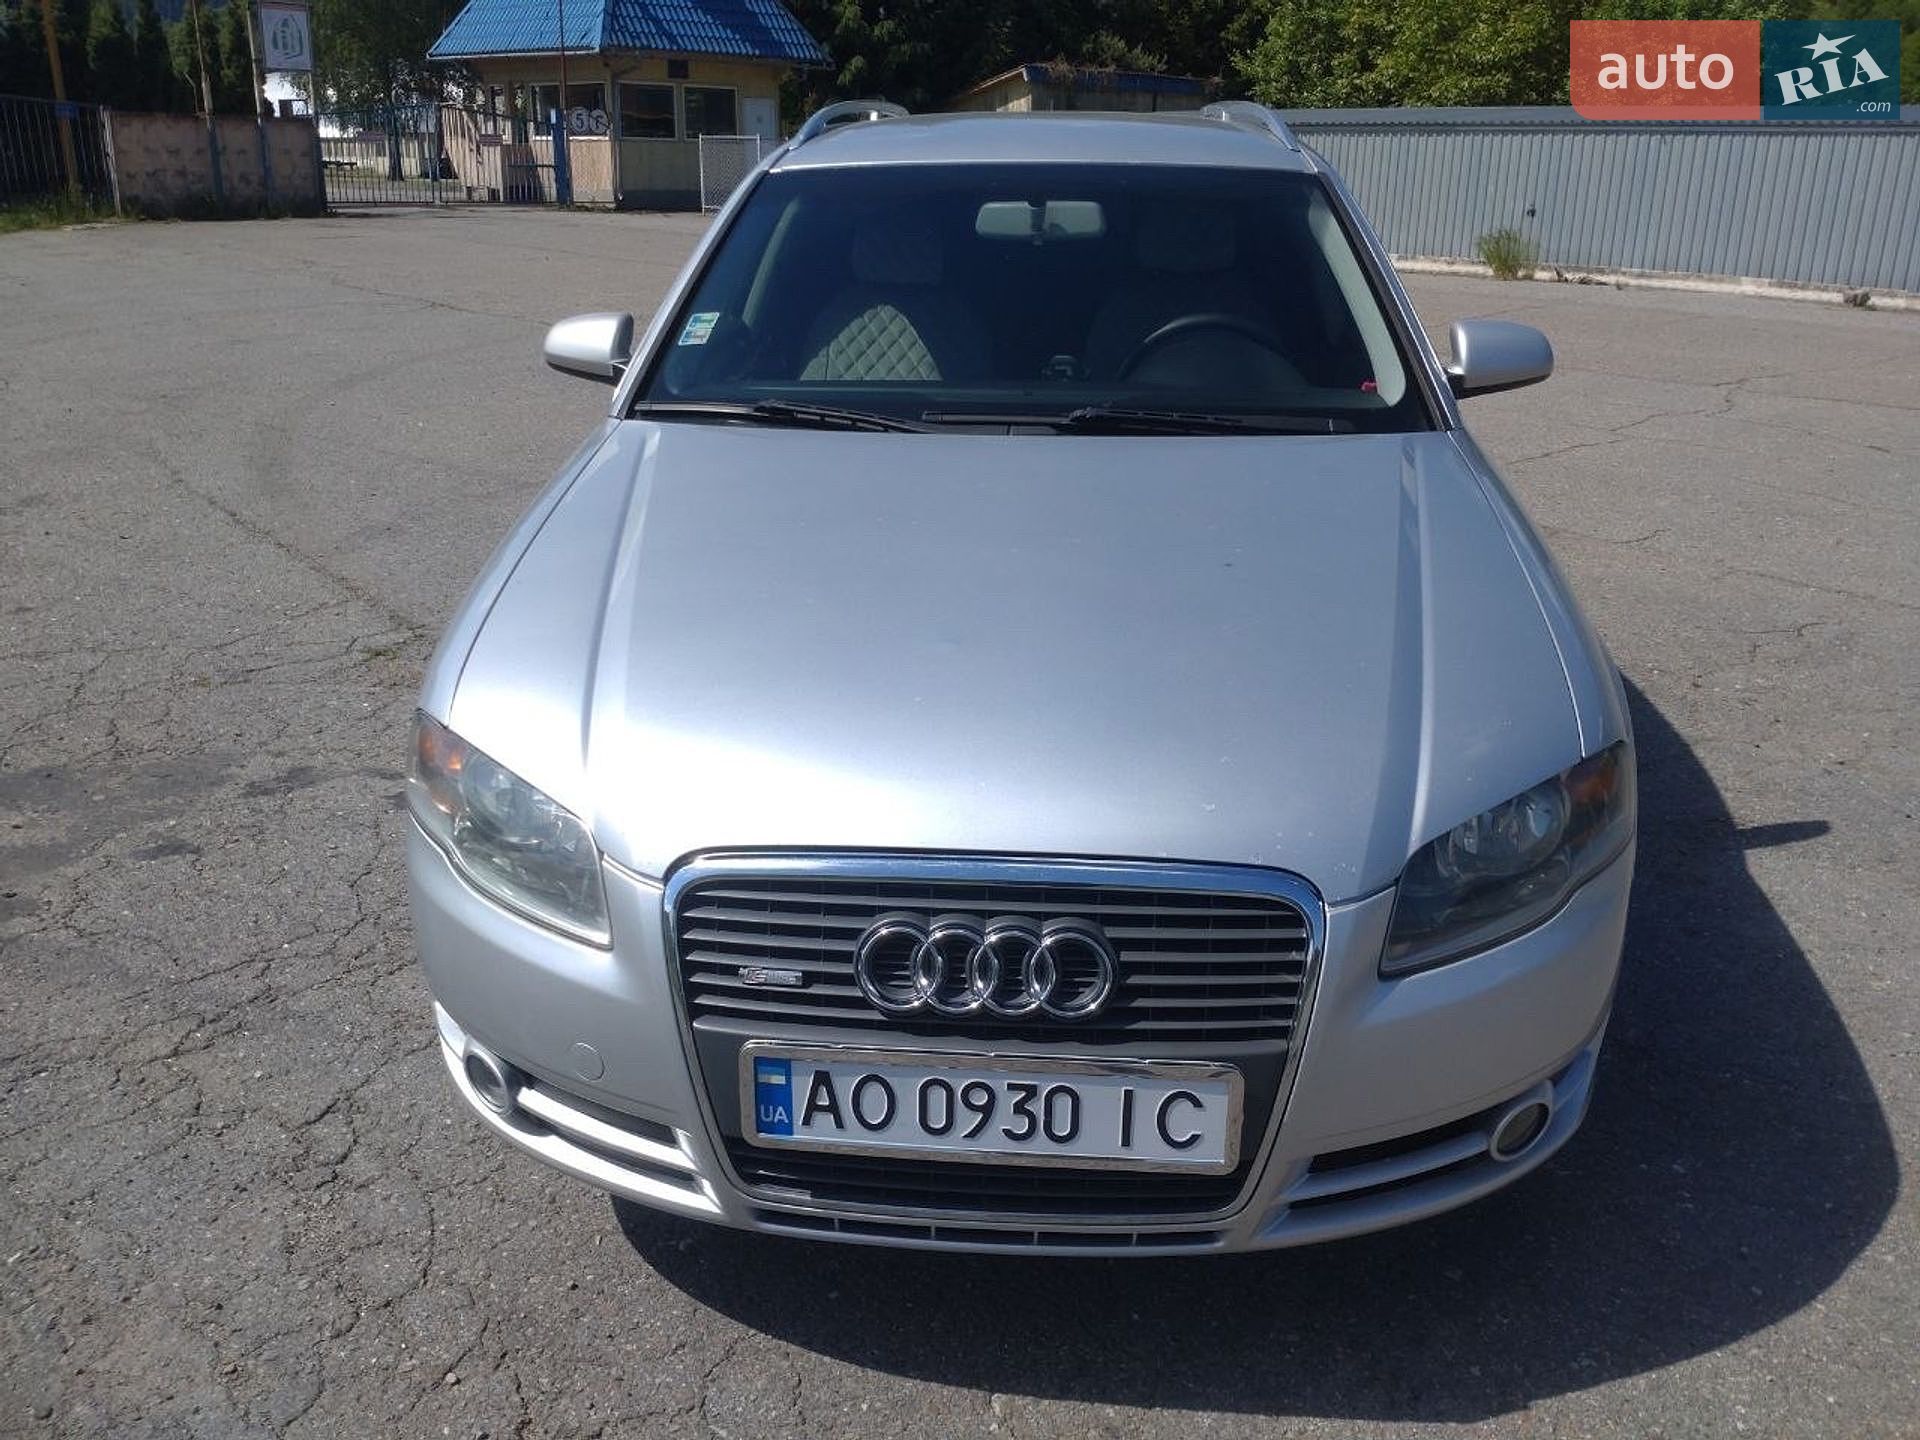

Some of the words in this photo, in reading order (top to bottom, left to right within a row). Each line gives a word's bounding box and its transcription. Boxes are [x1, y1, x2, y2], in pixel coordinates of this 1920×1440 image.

[760, 1105, 789, 1123] UA
[801, 1069, 896, 1132] AO
[917, 1077, 1080, 1144] 0930
[1120, 1087, 1204, 1149] IC
